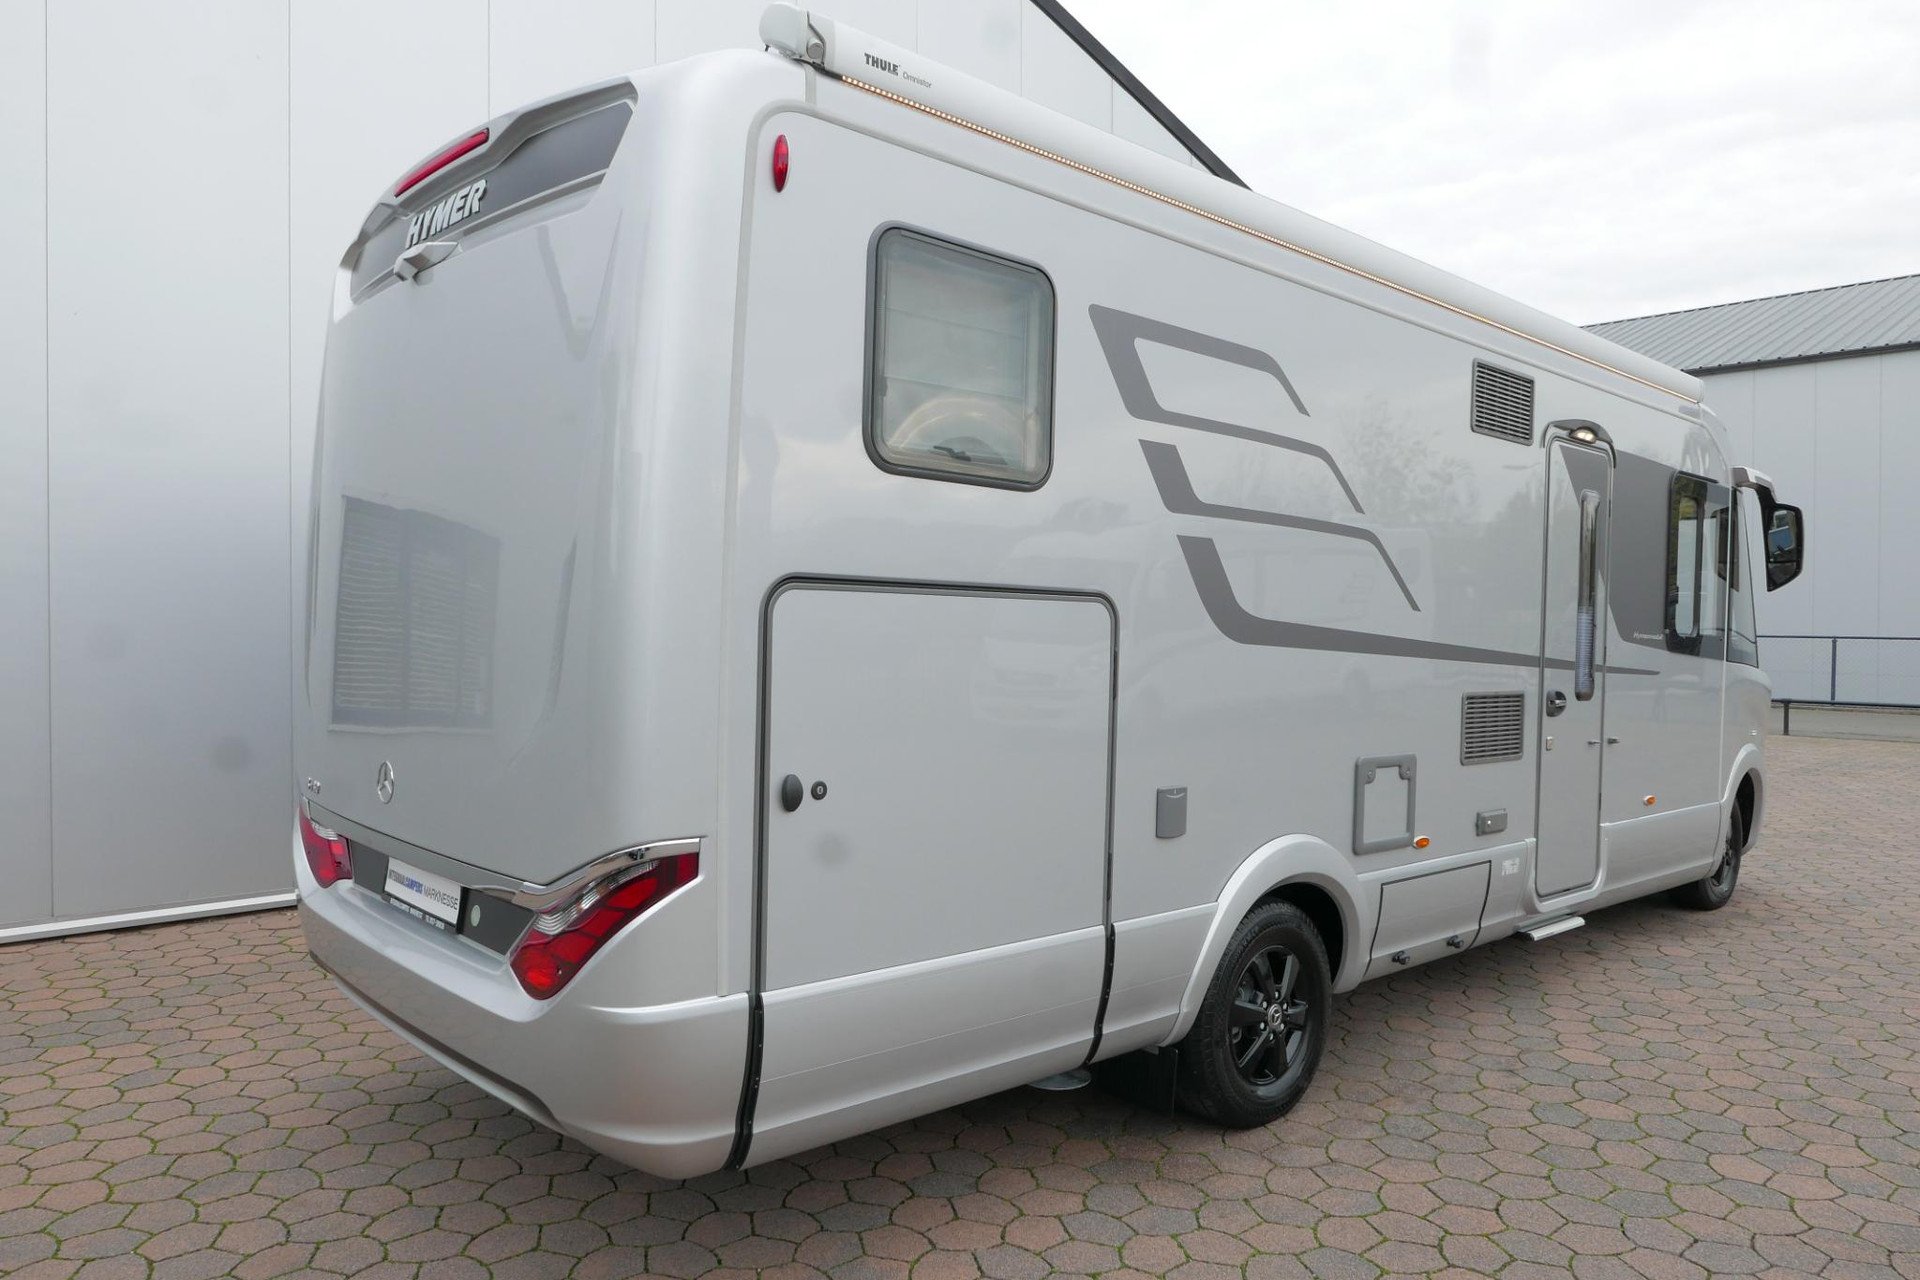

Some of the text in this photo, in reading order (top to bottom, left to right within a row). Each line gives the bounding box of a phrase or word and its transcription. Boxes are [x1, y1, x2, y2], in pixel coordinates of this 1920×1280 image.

[864, 52, 899, 76] THULE
[405, 179, 487, 250] HYMER
[424, 884, 459, 911] MARKNESSE
